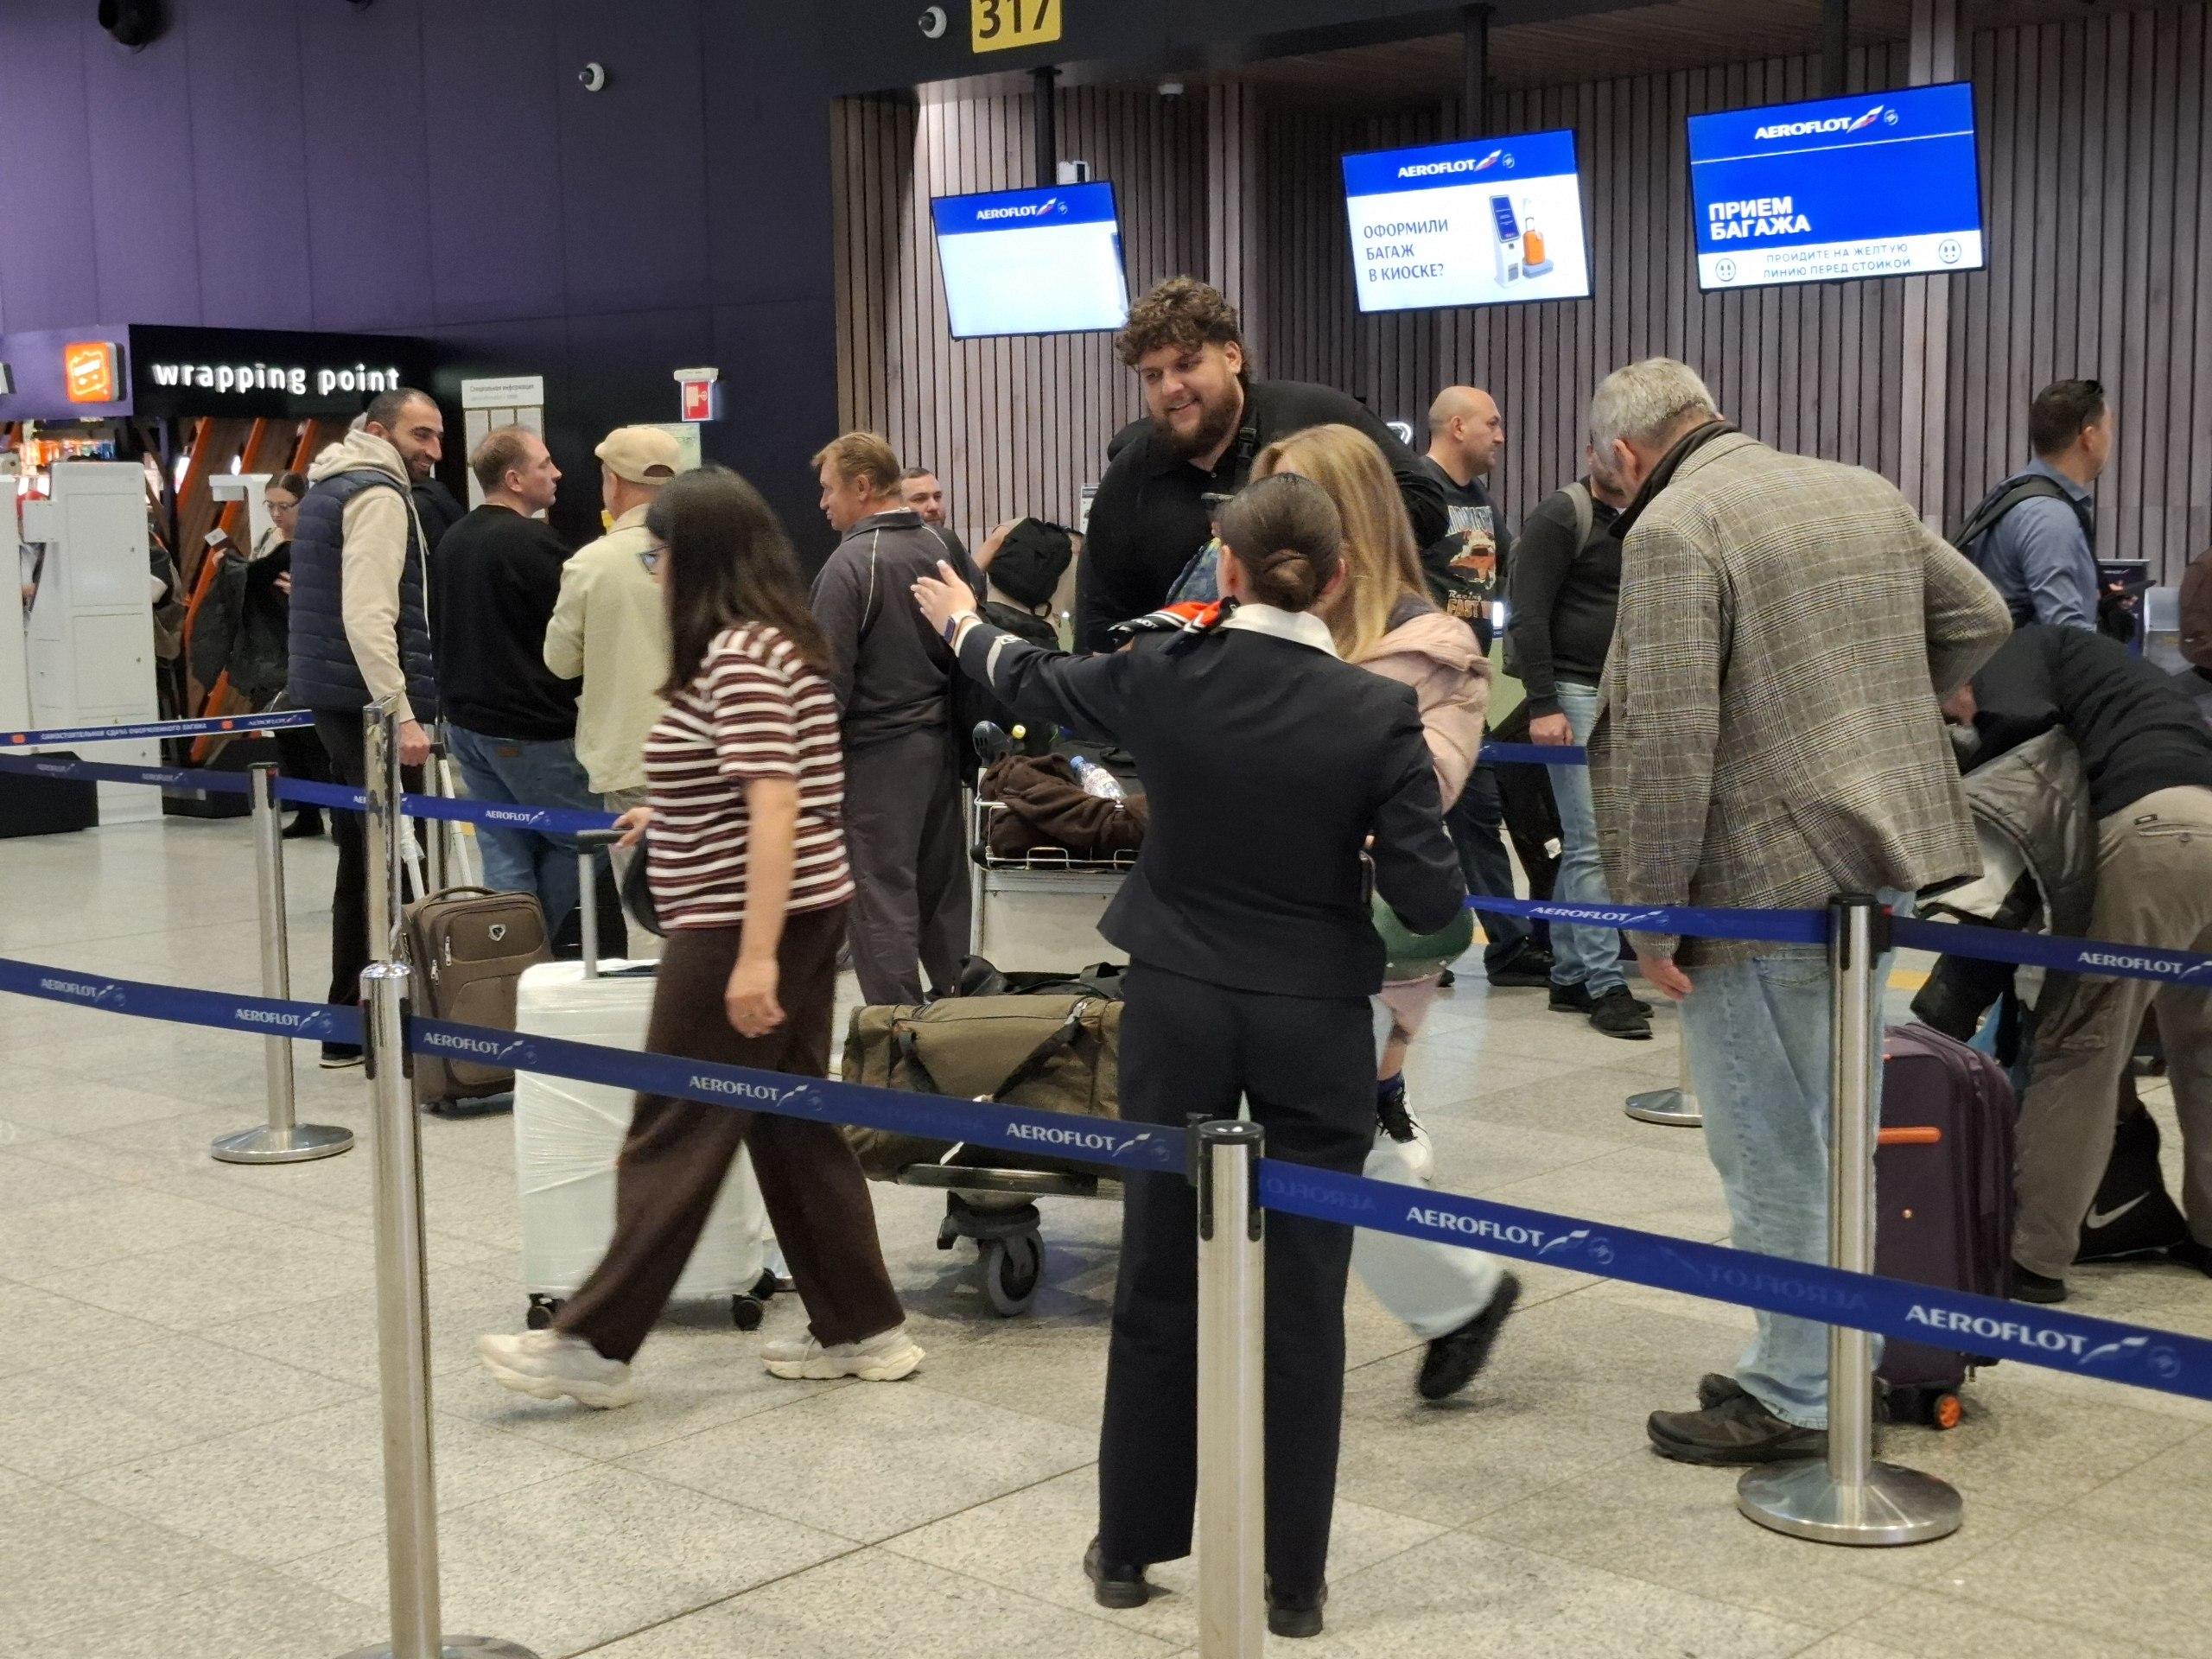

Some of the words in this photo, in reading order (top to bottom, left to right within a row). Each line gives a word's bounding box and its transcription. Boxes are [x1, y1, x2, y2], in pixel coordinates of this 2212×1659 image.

[979, 0, 1048, 39] 317
[1755, 117, 1853, 140] AEROFLOT
[1397, 158, 1477, 178] AEROFLOT
[976, 205, 1038, 221] AEROFLOT
[1708, 195, 1793, 221] ПРИЕМ
[1363, 219, 1449, 239] ОФОРМИЛИ
[1711, 214, 1812, 241] БАГАЖА
[1366, 244, 1415, 261] БАГАЖ
[1766, 245, 1830, 264] ПРОЙДИТЕ
[1834, 244, 1850, 258] НА
[1854, 242, 1909, 257] ЖЕЛТУЮ
[1369, 269, 1378, 283] В
[1382, 263, 1445, 281] КИОСКЕ?
[1764, 263, 1807, 279] ЛИНИЮ
[1810, 262, 1850, 276] ПЕРЕД
[1853, 257, 1911, 272] СТОЙКОЙ
[151, 362, 308, 396] wrapping
[317, 362, 400, 396] point
[486, 810, 531, 821] AEROFLOT
[1529, 906, 1631, 921] AEROFLOT
[2077, 951, 2183, 975] AEROFLOT
[40, 977, 97, 998] AEROFLOT
[235, 1007, 300, 1028] AEROFLOT
[423, 1032, 500, 1056] AEROFLOT
[690, 1075, 779, 1102] AEROFLOT
[1006, 1122, 1116, 1152] AEROFLOT
[1406, 1206, 1546, 1248] AEROFLOT
[1905, 1304, 2088, 1355] AEROFLOT
